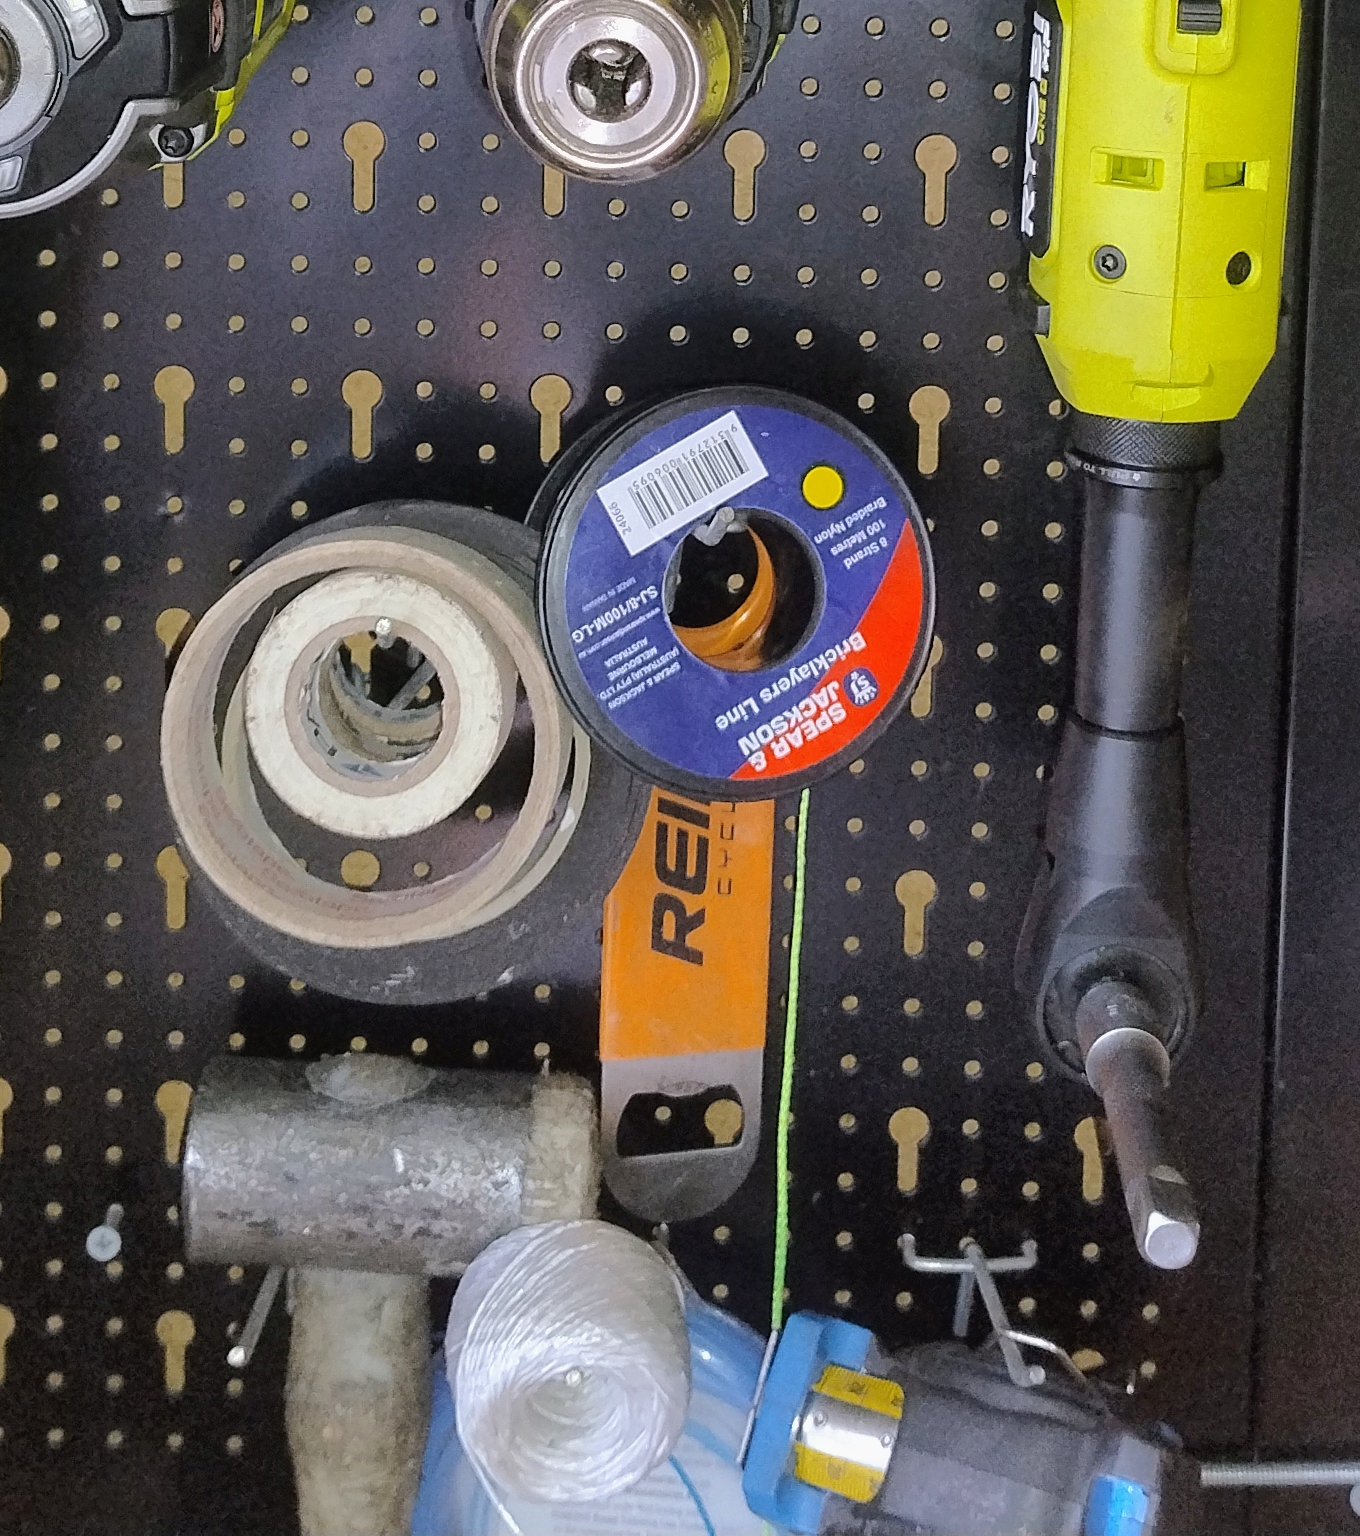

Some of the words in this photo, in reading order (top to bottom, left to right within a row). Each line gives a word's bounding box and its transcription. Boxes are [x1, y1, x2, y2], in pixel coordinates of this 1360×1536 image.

[1021, 10, 1044, 237] RYOBI
[607, 499, 633, 536] 24066
[843, 495, 887, 528] Braided
[864, 517, 886, 537] 100
[812, 518, 847, 546] Nylon
[827, 529, 867, 557] Metres
[877, 535, 888, 548] 8
[842, 540, 880, 570] Strand
[569, 584, 659, 644] SJ-8/100M-LG
[757, 630, 867, 705] Bricklayers
[848, 674, 869, 694] SJ
[712, 695, 760, 733] Line
[736, 679, 844, 756] JACKSON
[768, 701, 847, 760] SPEAR
[746, 749, 769, 774] &
[650, 793, 710, 966] REI
